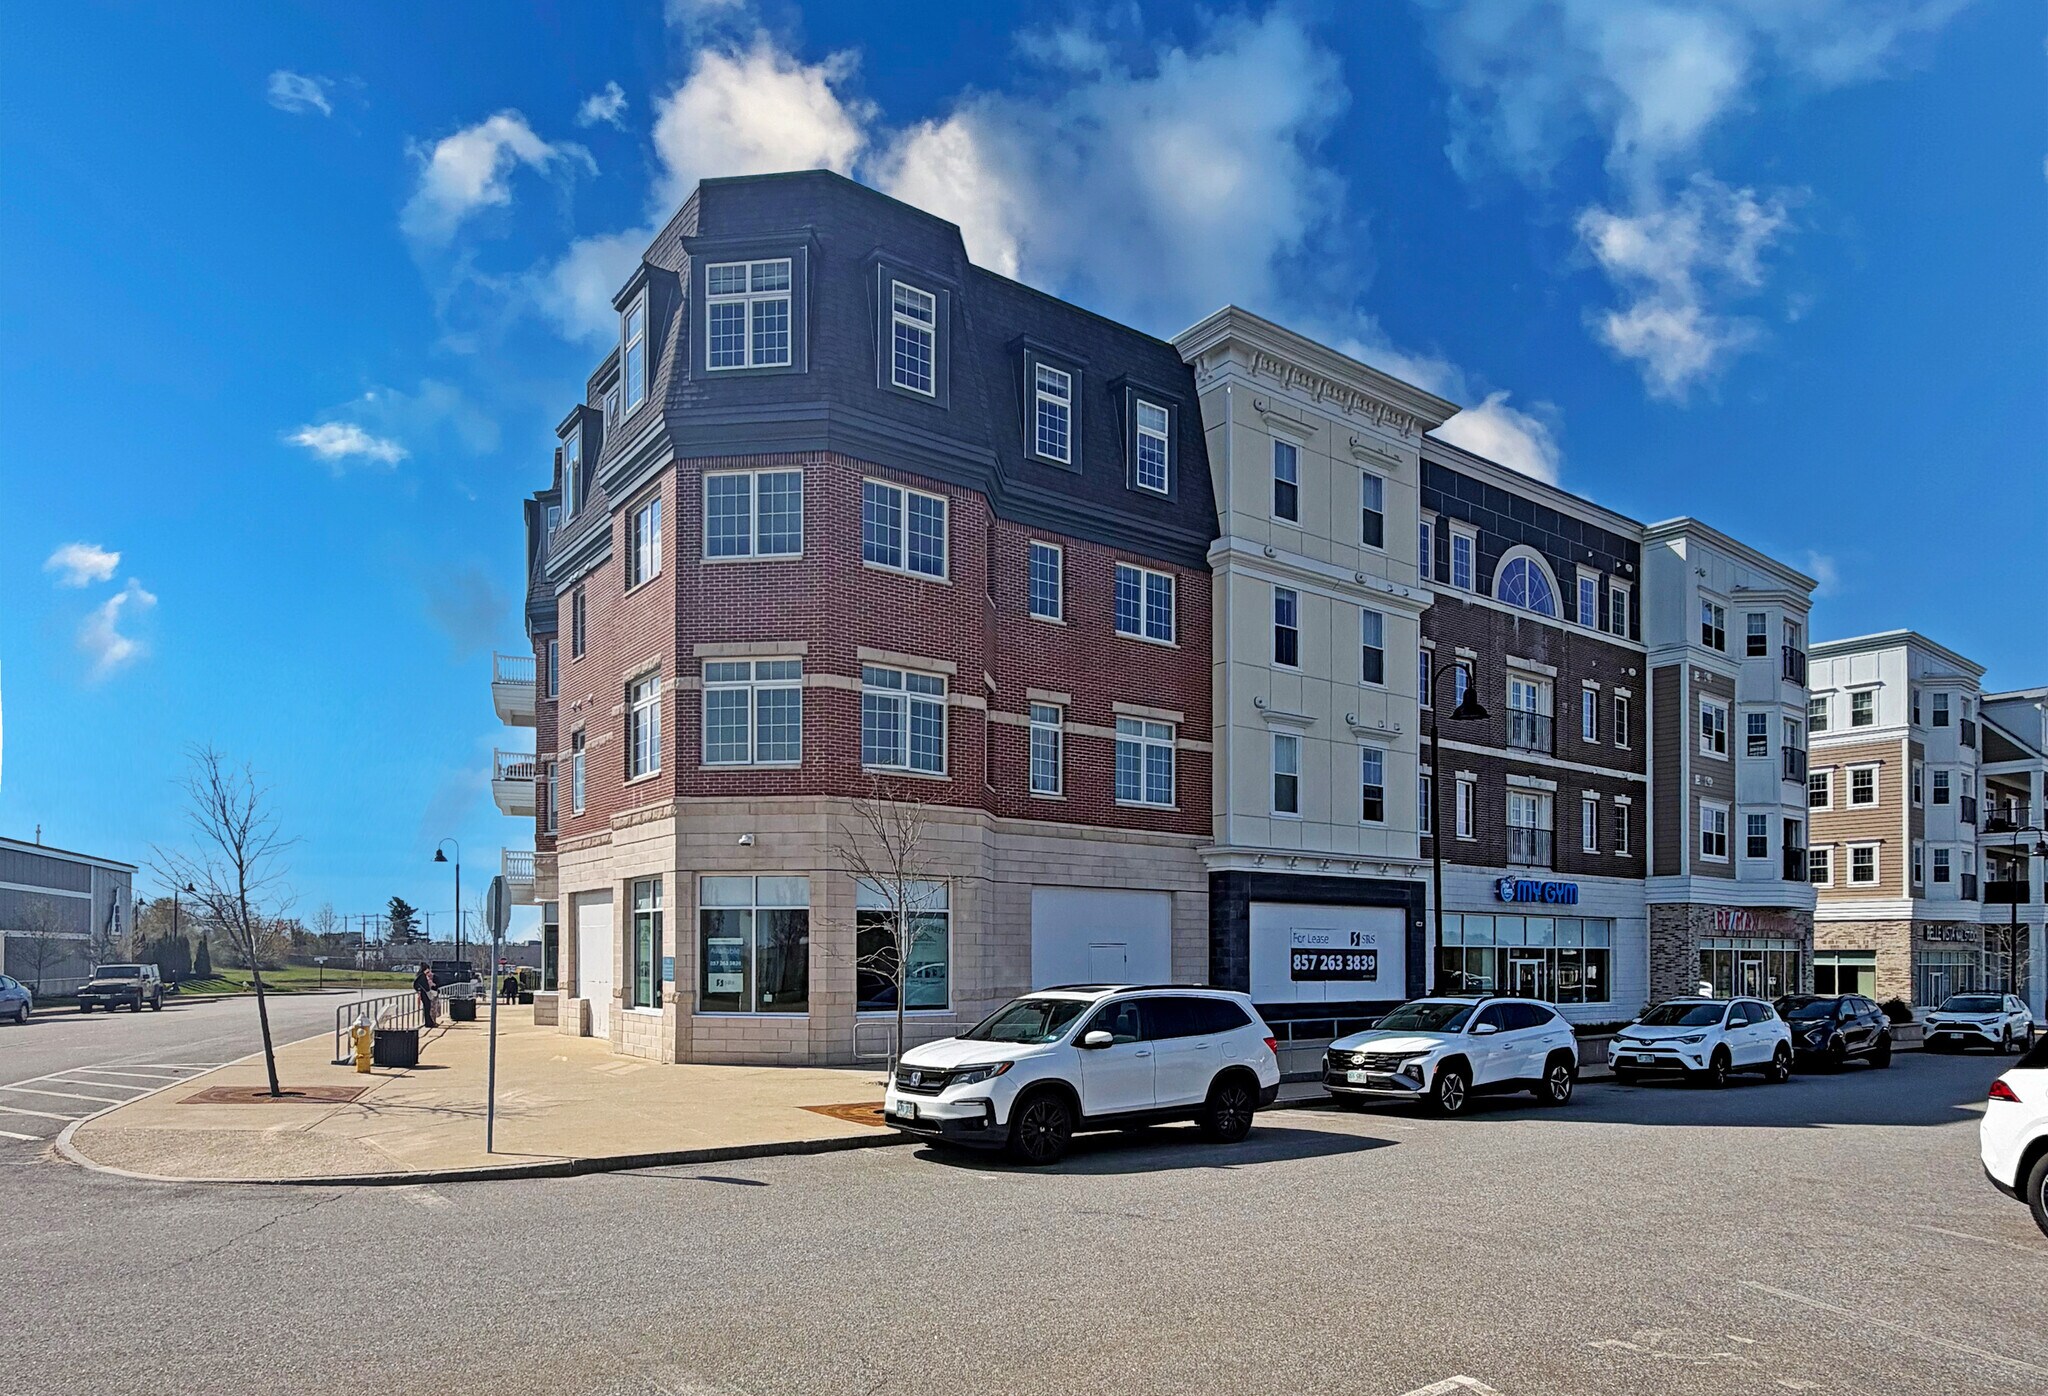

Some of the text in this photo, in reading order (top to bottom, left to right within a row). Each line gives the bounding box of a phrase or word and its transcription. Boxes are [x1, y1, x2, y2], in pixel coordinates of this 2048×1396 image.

[1517, 880, 1578, 904] MY GYM
[1293, 933, 1329, 944] For Lease
[1361, 935, 1375, 944] SRS
[1293, 954, 1375, 970] 857 263 3839
